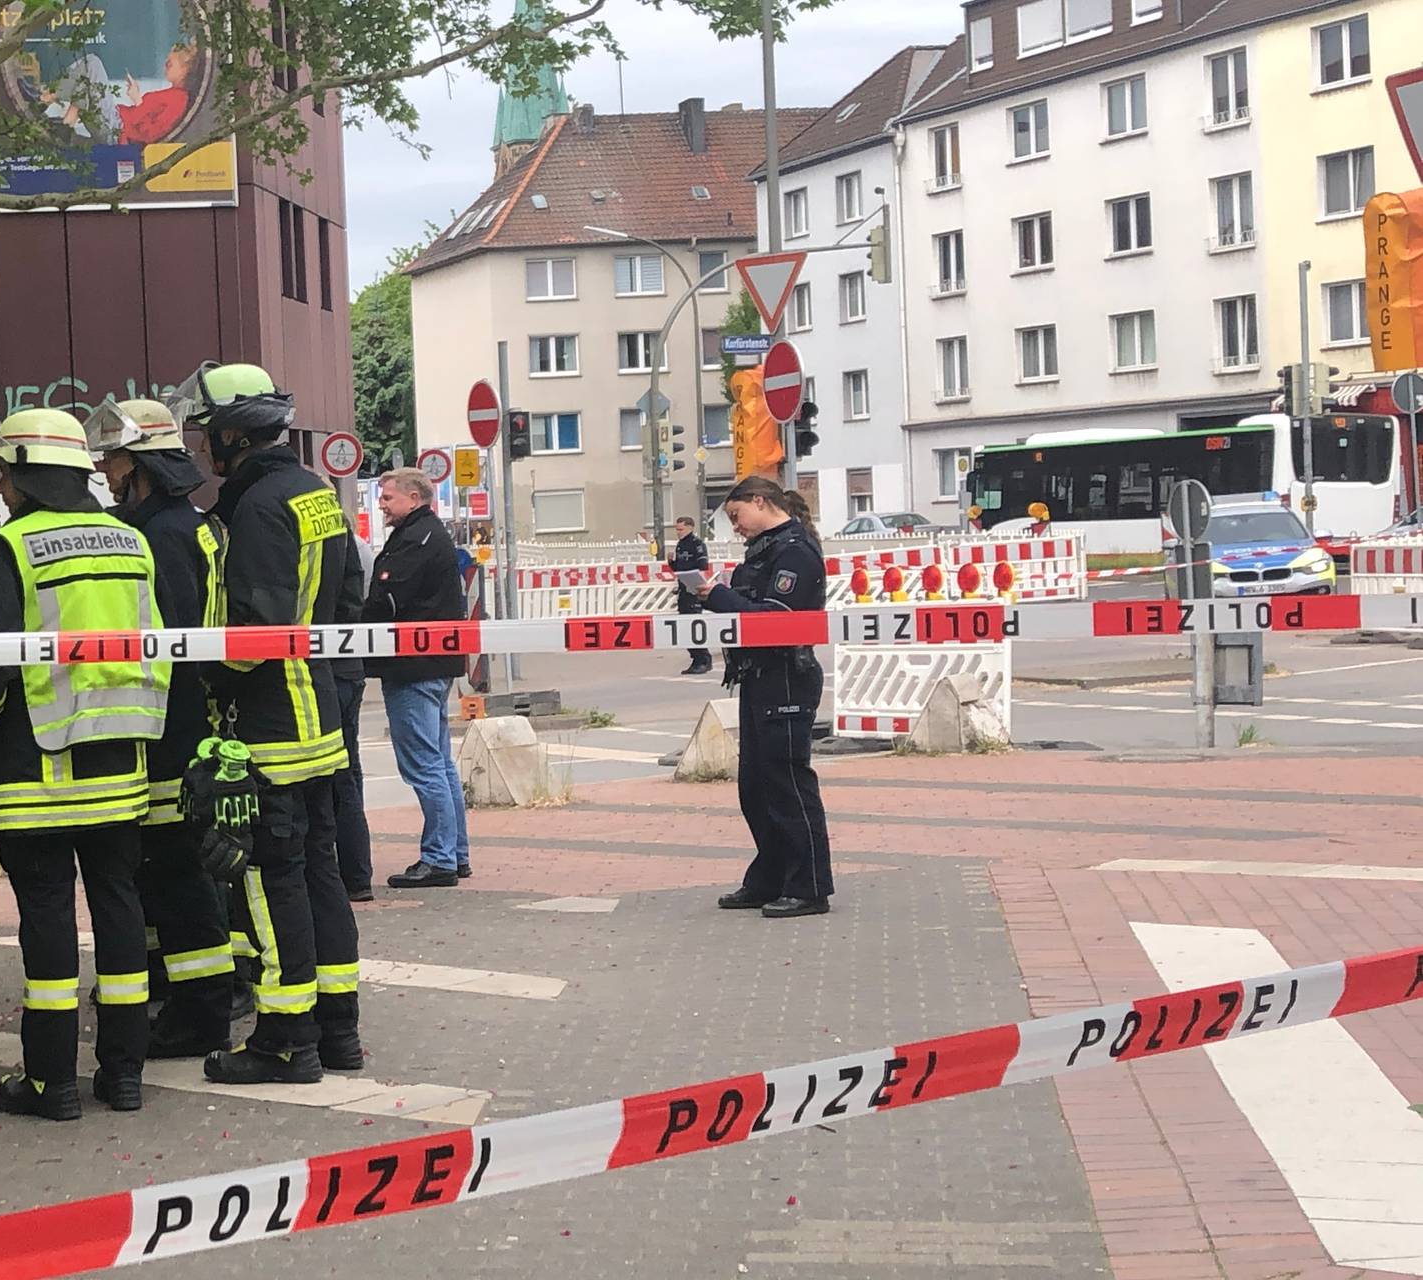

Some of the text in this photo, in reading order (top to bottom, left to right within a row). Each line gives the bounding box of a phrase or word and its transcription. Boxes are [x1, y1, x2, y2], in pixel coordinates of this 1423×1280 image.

[1376, 212, 1393, 350] PRANGE
[735, 384, 745, 475] PRANGE
[29, 531, 140, 559] Einsatzleiter
[564, 618, 738, 648] POLIZEI
[843, 609, 1020, 642] POLIZEI
[1125, 601, 1304, 633] POLIZEI
[20, 633, 188, 661] POLIZEI
[288, 626, 460, 656] POLIZEI
[1068, 979, 1300, 1067] POLIZEI
[656, 1050, 938, 1153] POLIZEI
[144, 1137, 492, 1254] POLIZEI
